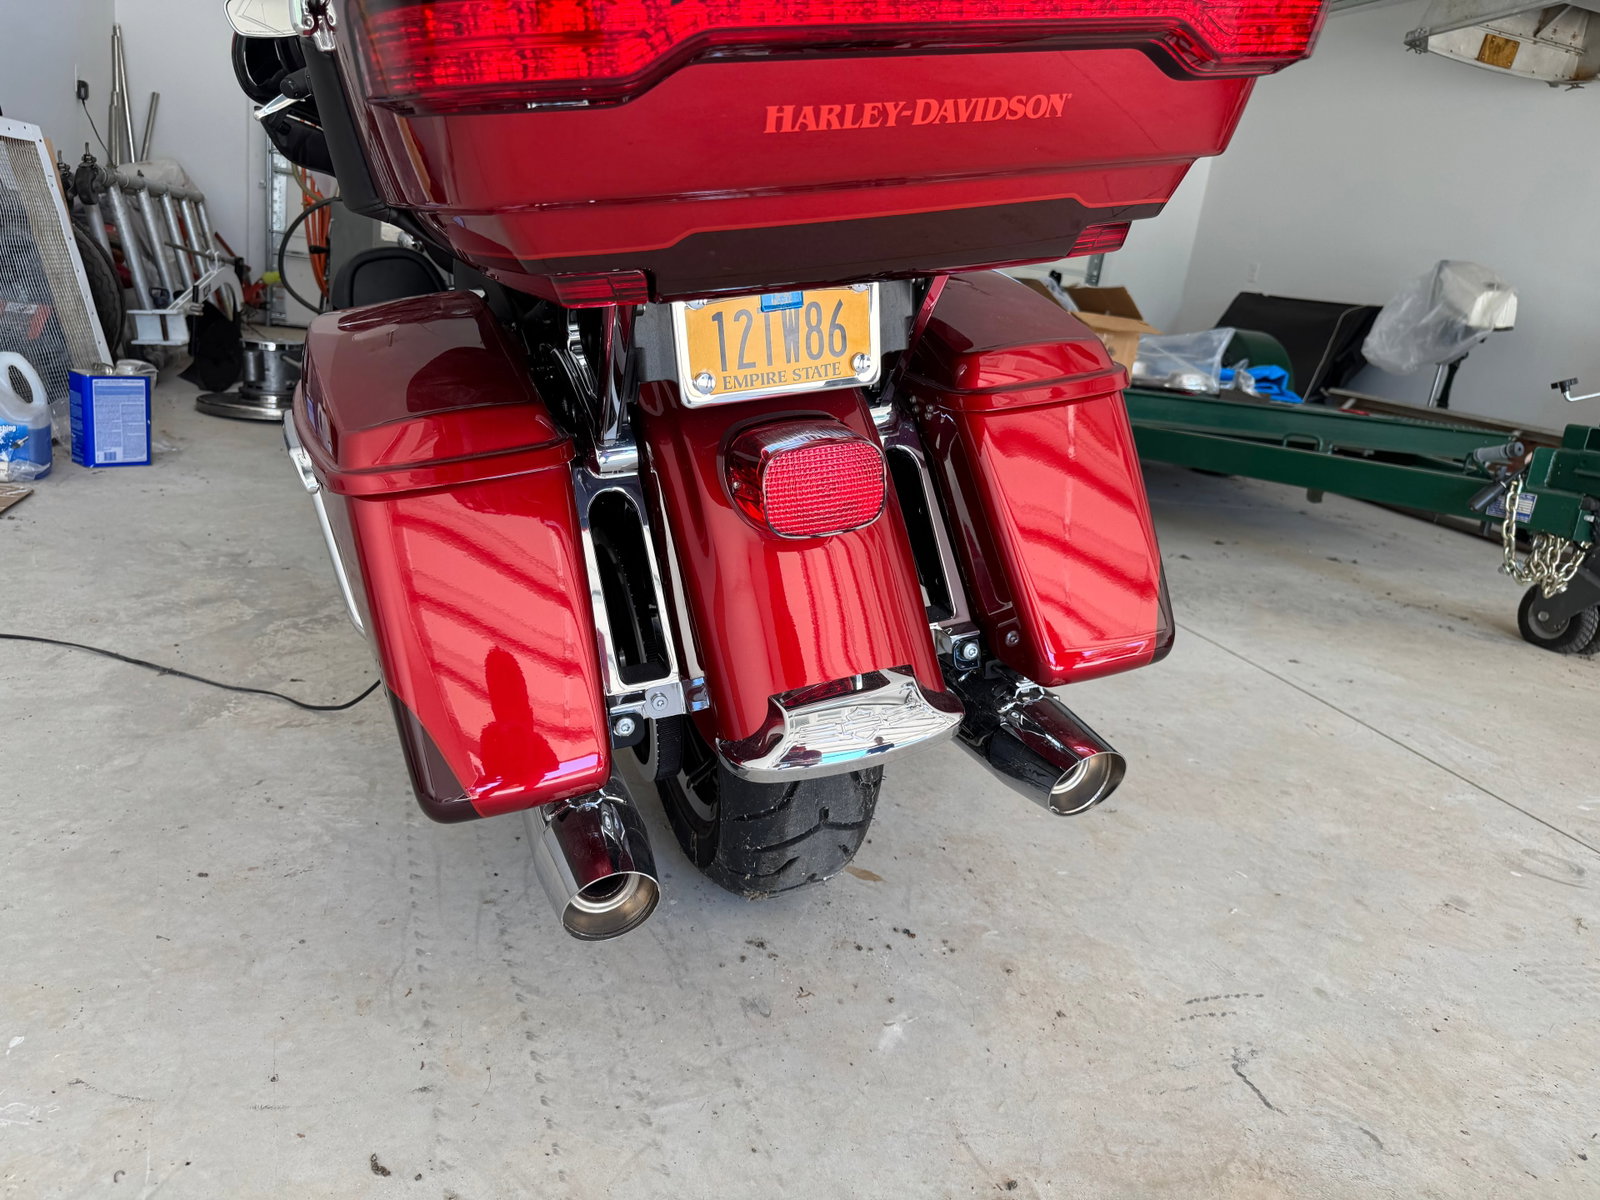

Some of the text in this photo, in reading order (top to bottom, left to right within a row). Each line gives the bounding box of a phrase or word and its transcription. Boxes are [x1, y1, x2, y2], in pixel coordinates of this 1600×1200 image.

[763, 93, 1070, 134] HARLEY-DAVIDSON
[711, 298, 848, 372] 12TW86
[722, 361, 842, 391] EMPIRE STATE
